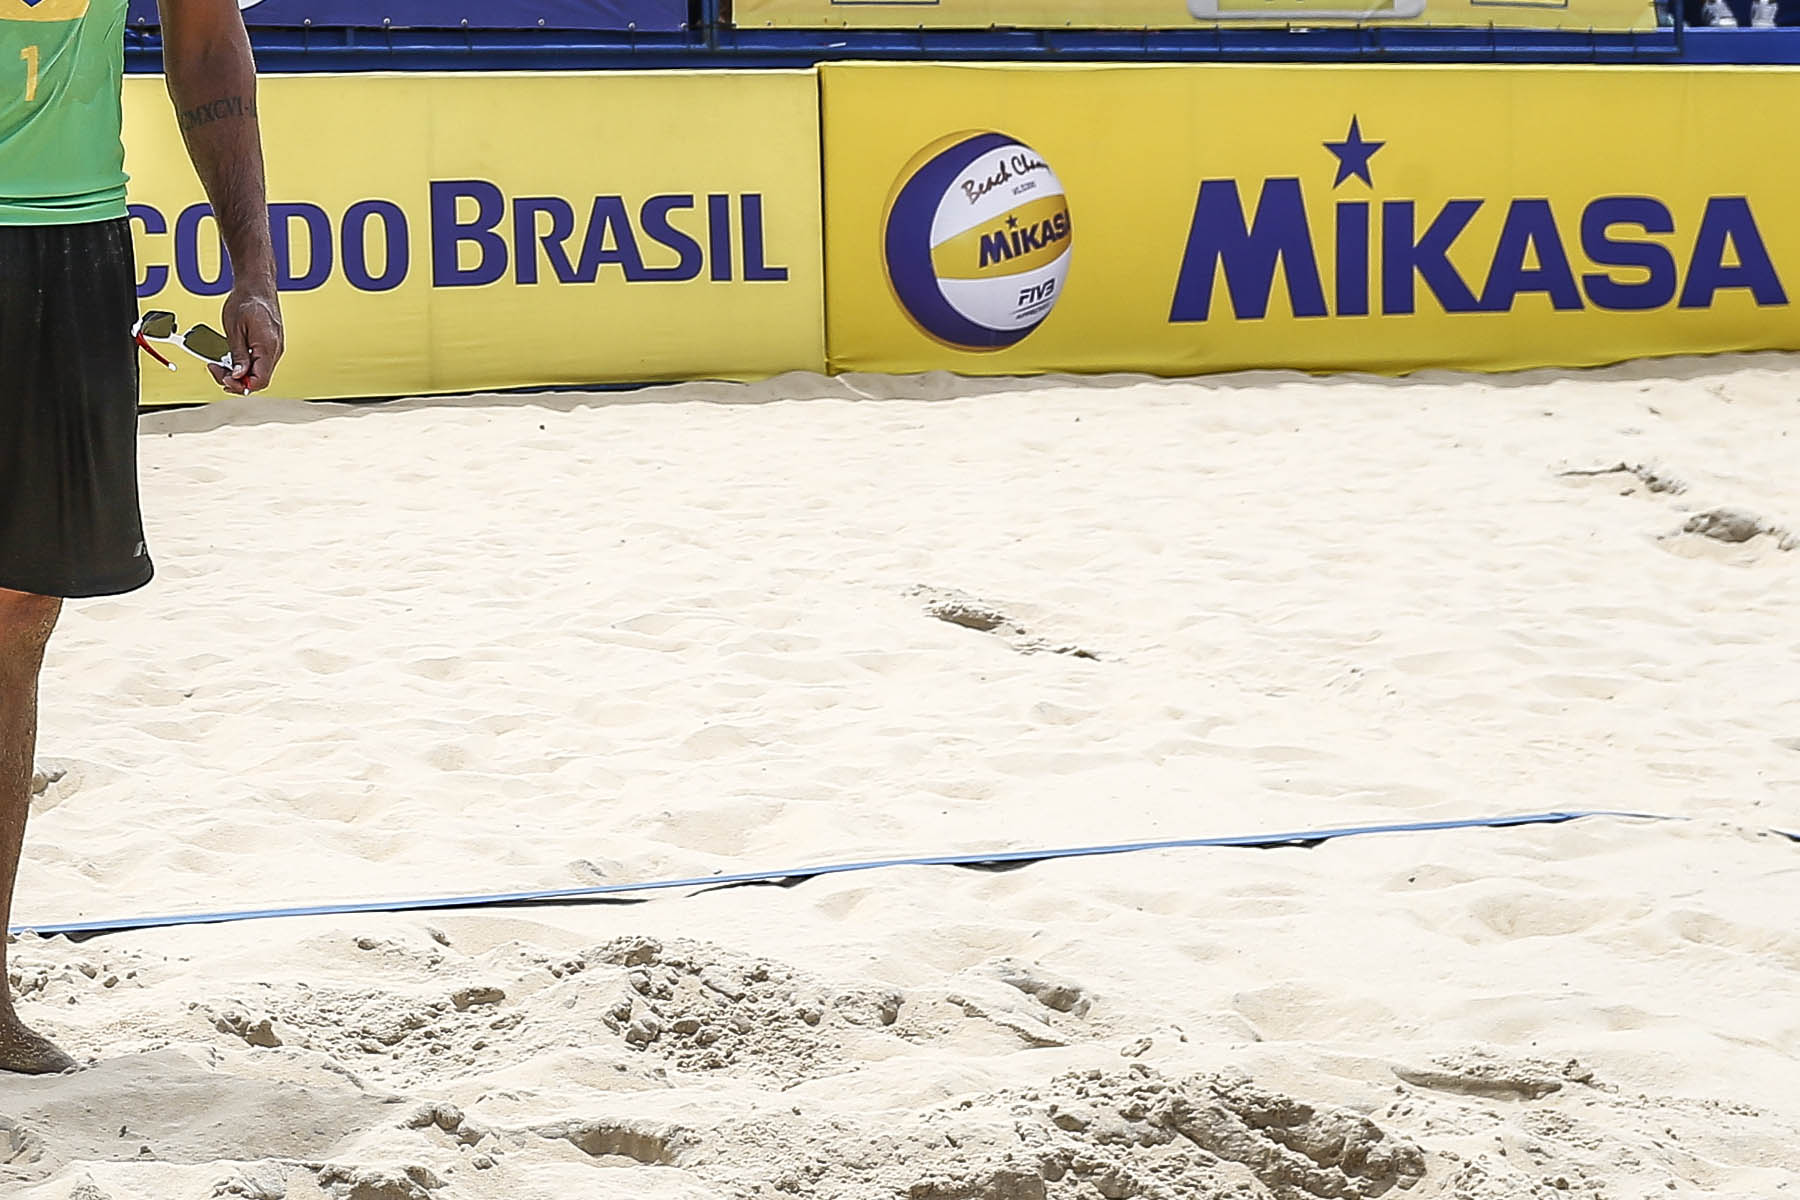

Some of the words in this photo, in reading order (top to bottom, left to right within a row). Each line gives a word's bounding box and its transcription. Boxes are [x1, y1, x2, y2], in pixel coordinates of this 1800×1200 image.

[19, 44, 39, 102] 1
[961, 160, 1012, 205] Beach
[270, 199, 410, 293] DO
[429, 179, 789, 287] BRASIL
